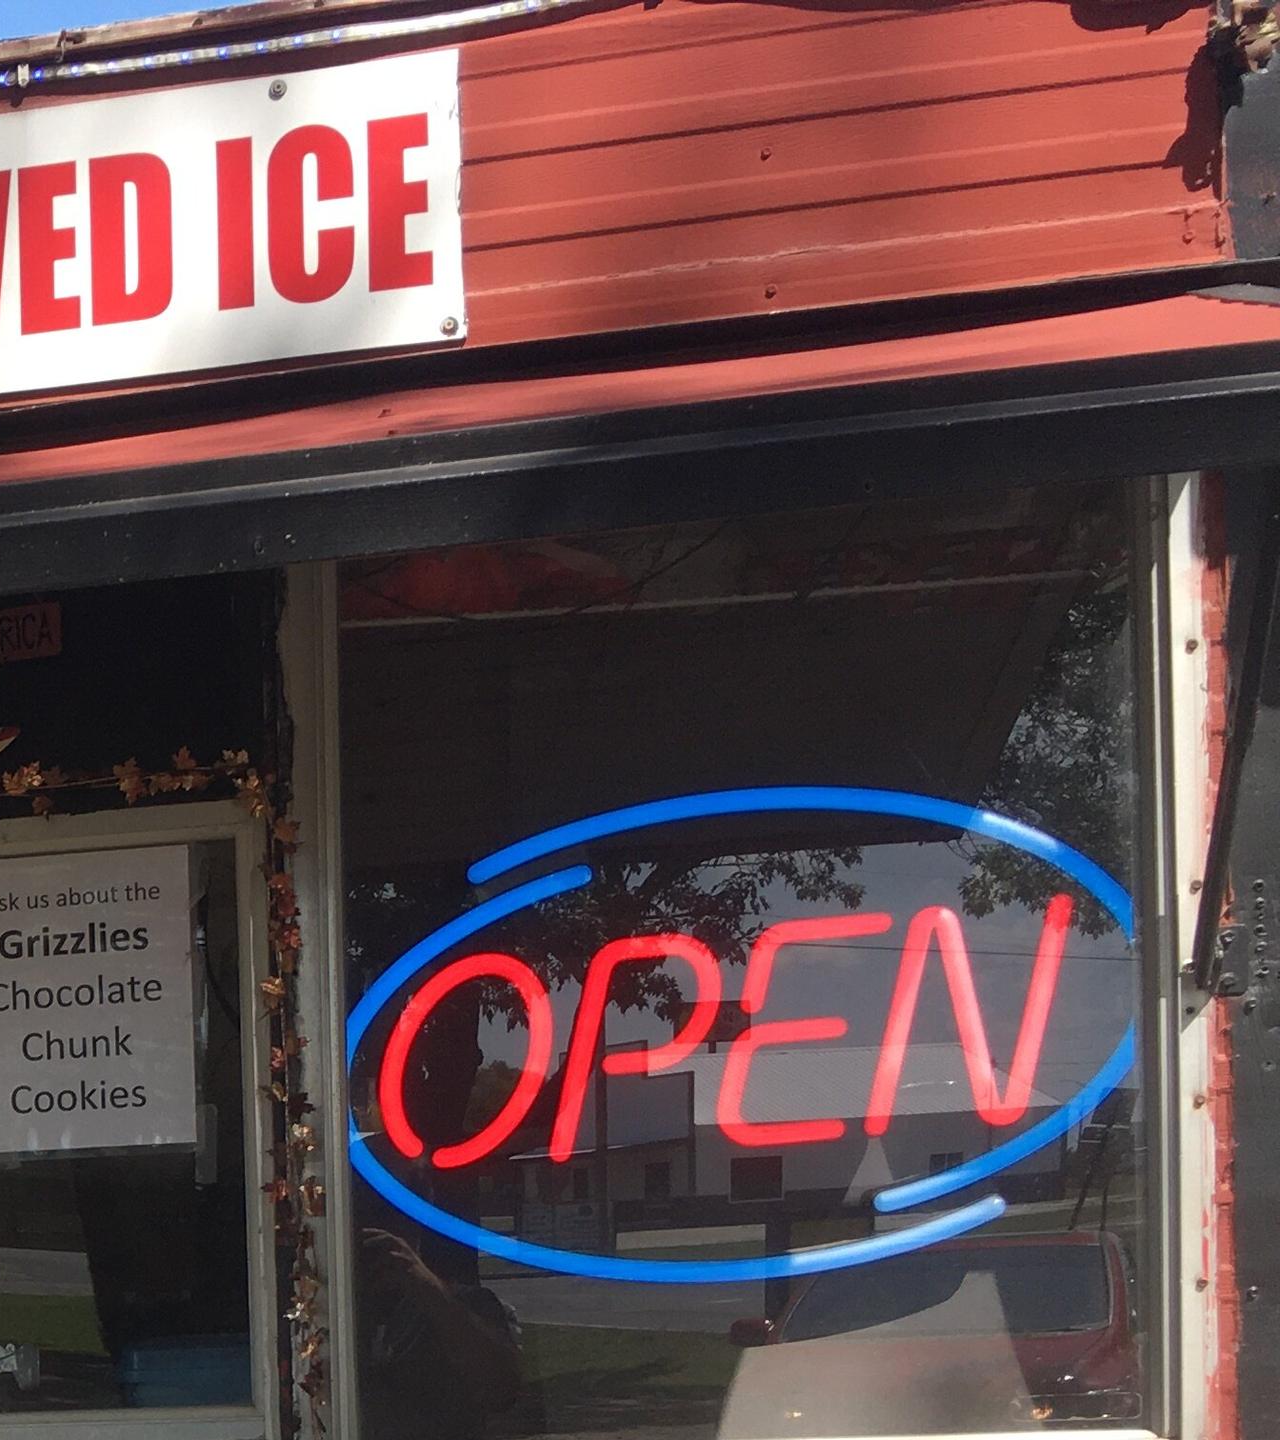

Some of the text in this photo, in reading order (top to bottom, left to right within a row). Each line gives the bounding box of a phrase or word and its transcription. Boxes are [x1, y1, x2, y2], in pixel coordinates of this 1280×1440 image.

[215, 111, 435, 311] ICE
[26, 895, 49, 909] us
[56, 886, 119, 907] about
[124, 882, 161, 901] the
[21, 1025, 134, 1061] Chunk
[378, 893, 1074, 1169] OPEN
[11, 1080, 148, 1114] Cookies
